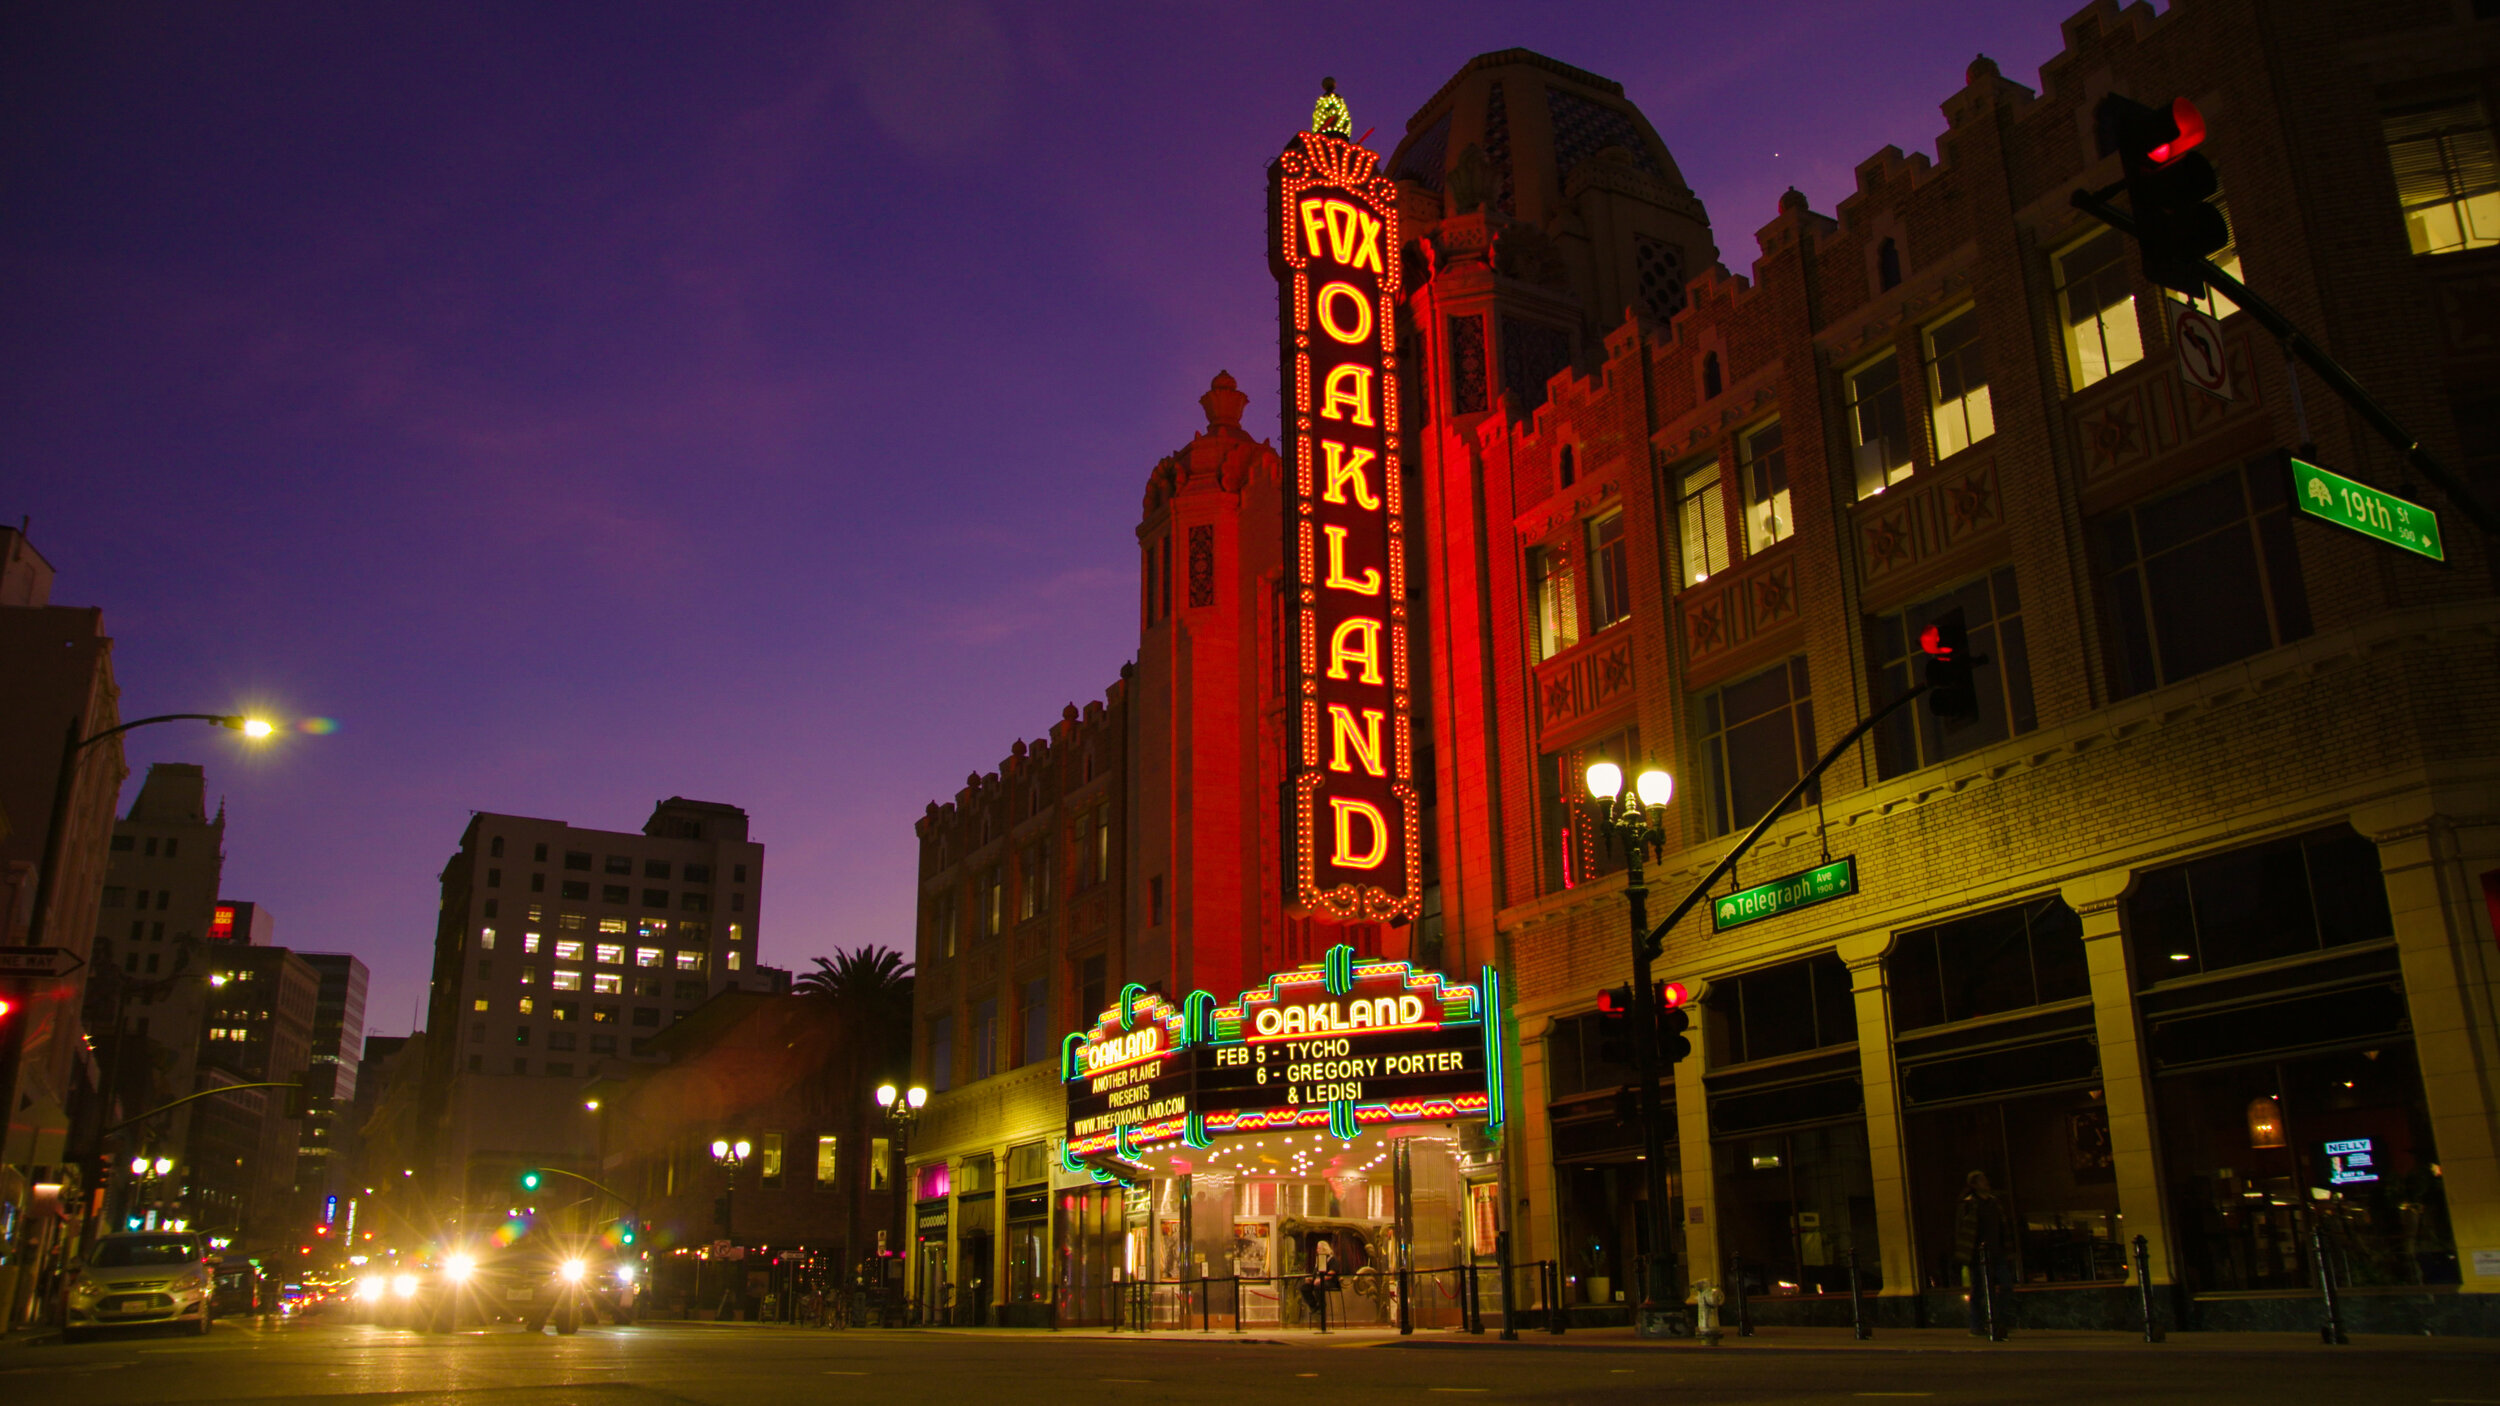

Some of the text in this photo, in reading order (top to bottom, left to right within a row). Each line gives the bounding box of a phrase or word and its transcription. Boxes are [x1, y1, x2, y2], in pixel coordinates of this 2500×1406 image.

[1300, 198, 1385, 274] FOX
[2341, 488, 2392, 532] 19th
[2397, 507, 2410, 524] St
[2398, 526, 2416, 542] 500
[1317, 280, 1388, 871] OAKLAND
[1816, 871, 1832, 883] Ave
[1817, 883, 1834, 893] 1900
[1737, 878, 1811, 916] Telegraph
[26, 956, 55, 968] WAY
[1256, 995, 1424, 1035] OAKLAND
[1088, 1027, 1157, 1070] OAKLAND
[1216, 1047, 1249, 1066] FEB
[1256, 1045, 1266, 1063] 5
[1286, 1038, 1350, 1060] TYCHO
[1092, 1060, 1161, 1094] ANOTHER PLANET
[1256, 1067, 1267, 1085] 6
[1287, 1058, 1378, 1083] GREGORY
[1385, 1051, 1464, 1075] PORTER
[1109, 1084, 1150, 1109] PRESENTS
[1287, 1082, 1362, 1104] & LEDISI
[1074, 1095, 1186, 1137] WWW.THEFOXOAKLAND.COM
[2328, 1140, 2367, 1152] NELLY
